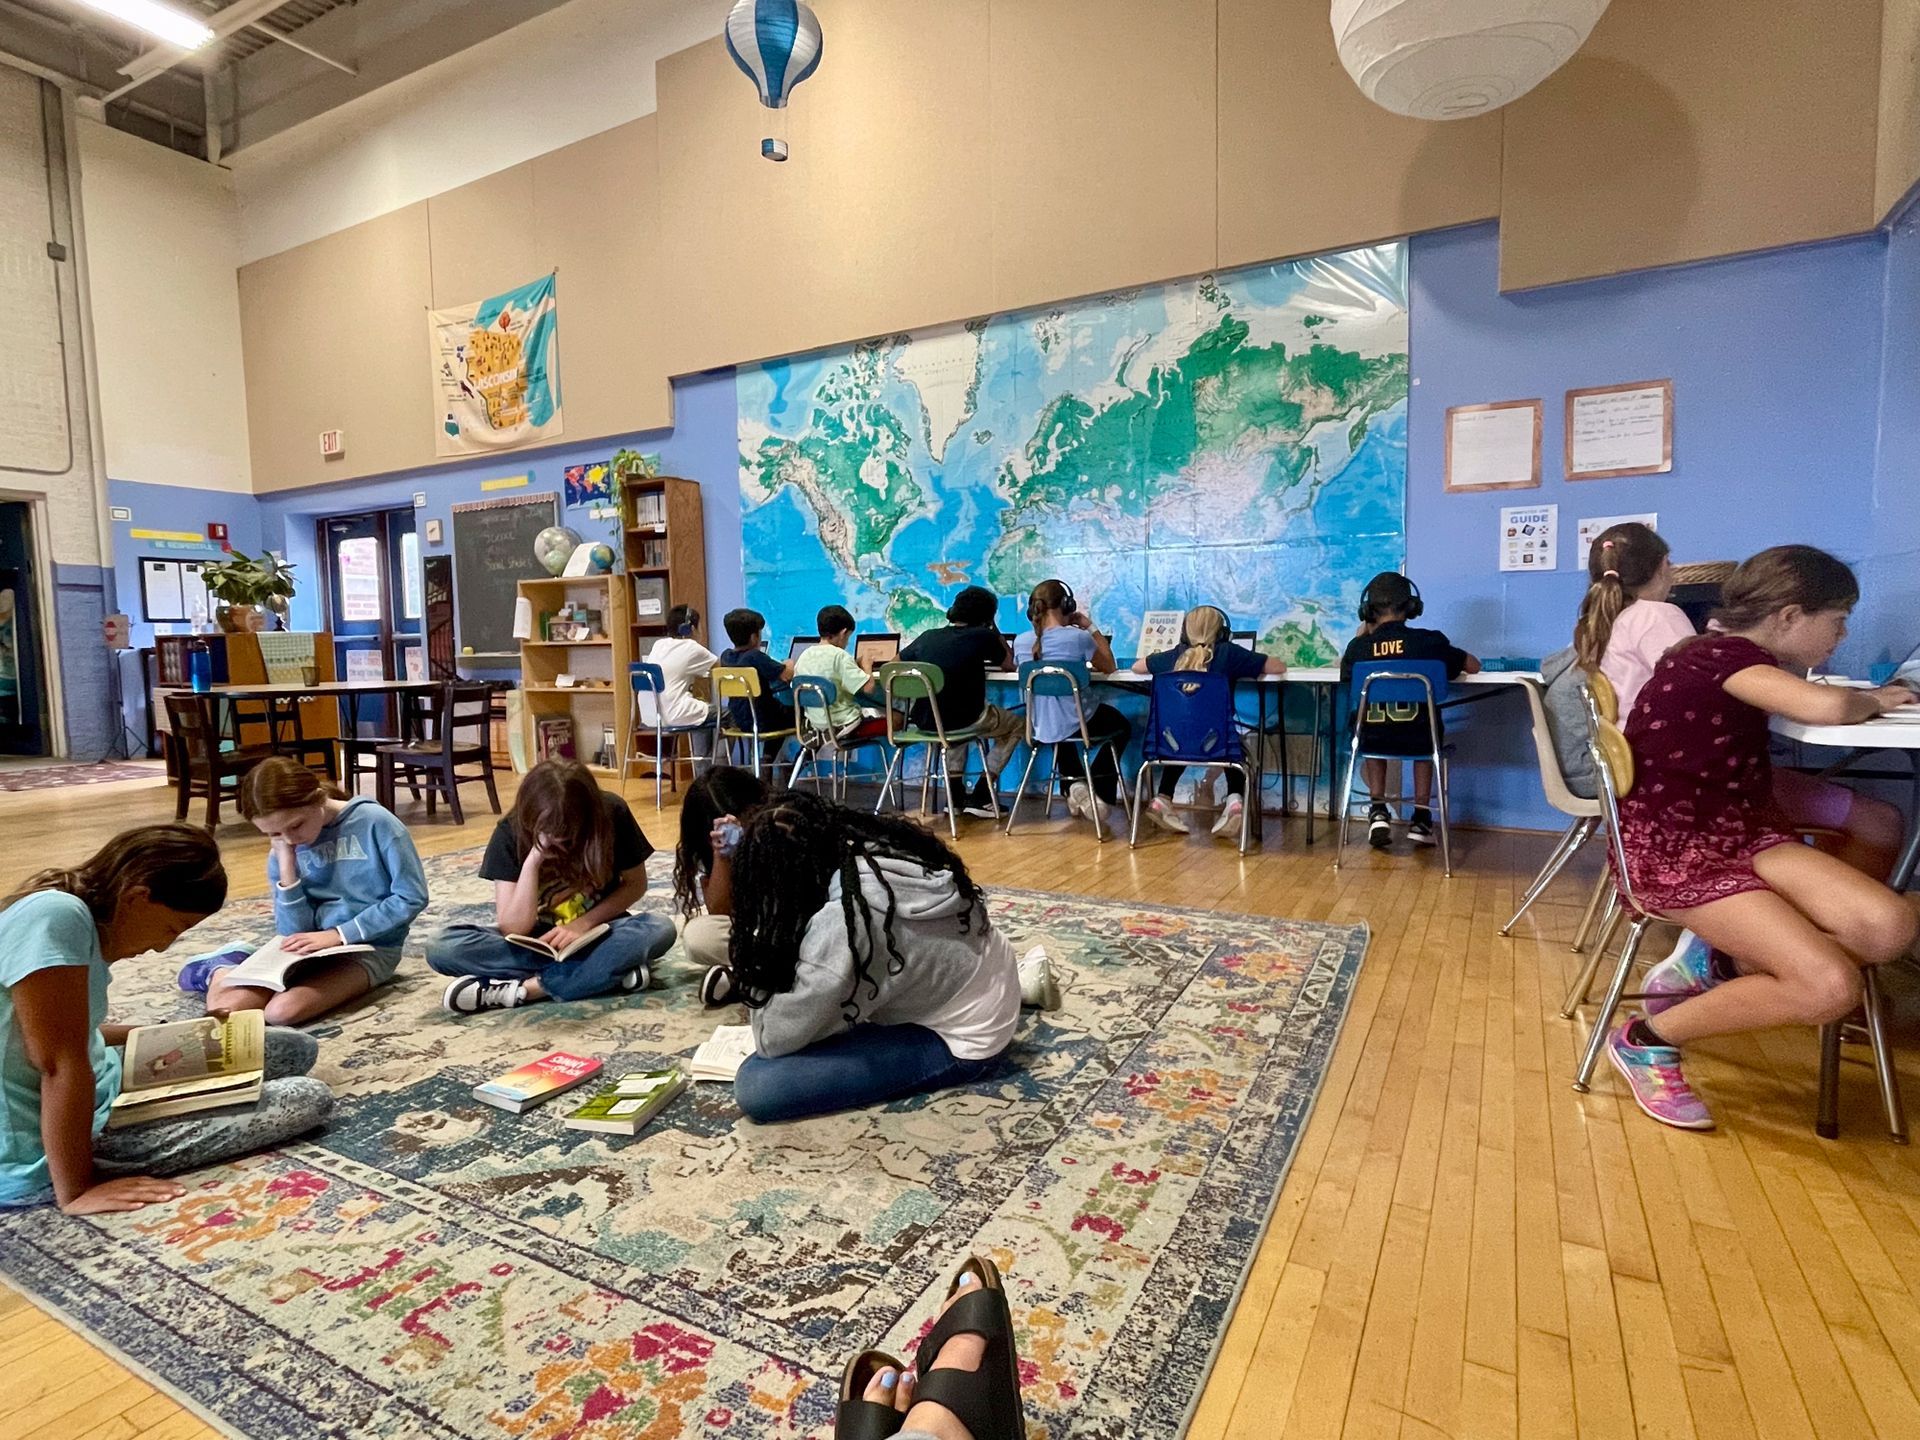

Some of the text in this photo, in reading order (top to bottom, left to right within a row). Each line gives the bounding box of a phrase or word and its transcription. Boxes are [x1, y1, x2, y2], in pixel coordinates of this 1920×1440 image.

[323, 432, 337, 452] EXIT
[1510, 514, 1549, 524] GUIDE
[1149, 617, 1177, 625] GUIDE
[1373, 640, 1404, 657] LOVE
[295, 834, 368, 877] PUMA
[549, 1055, 589, 1071] SUNNY
